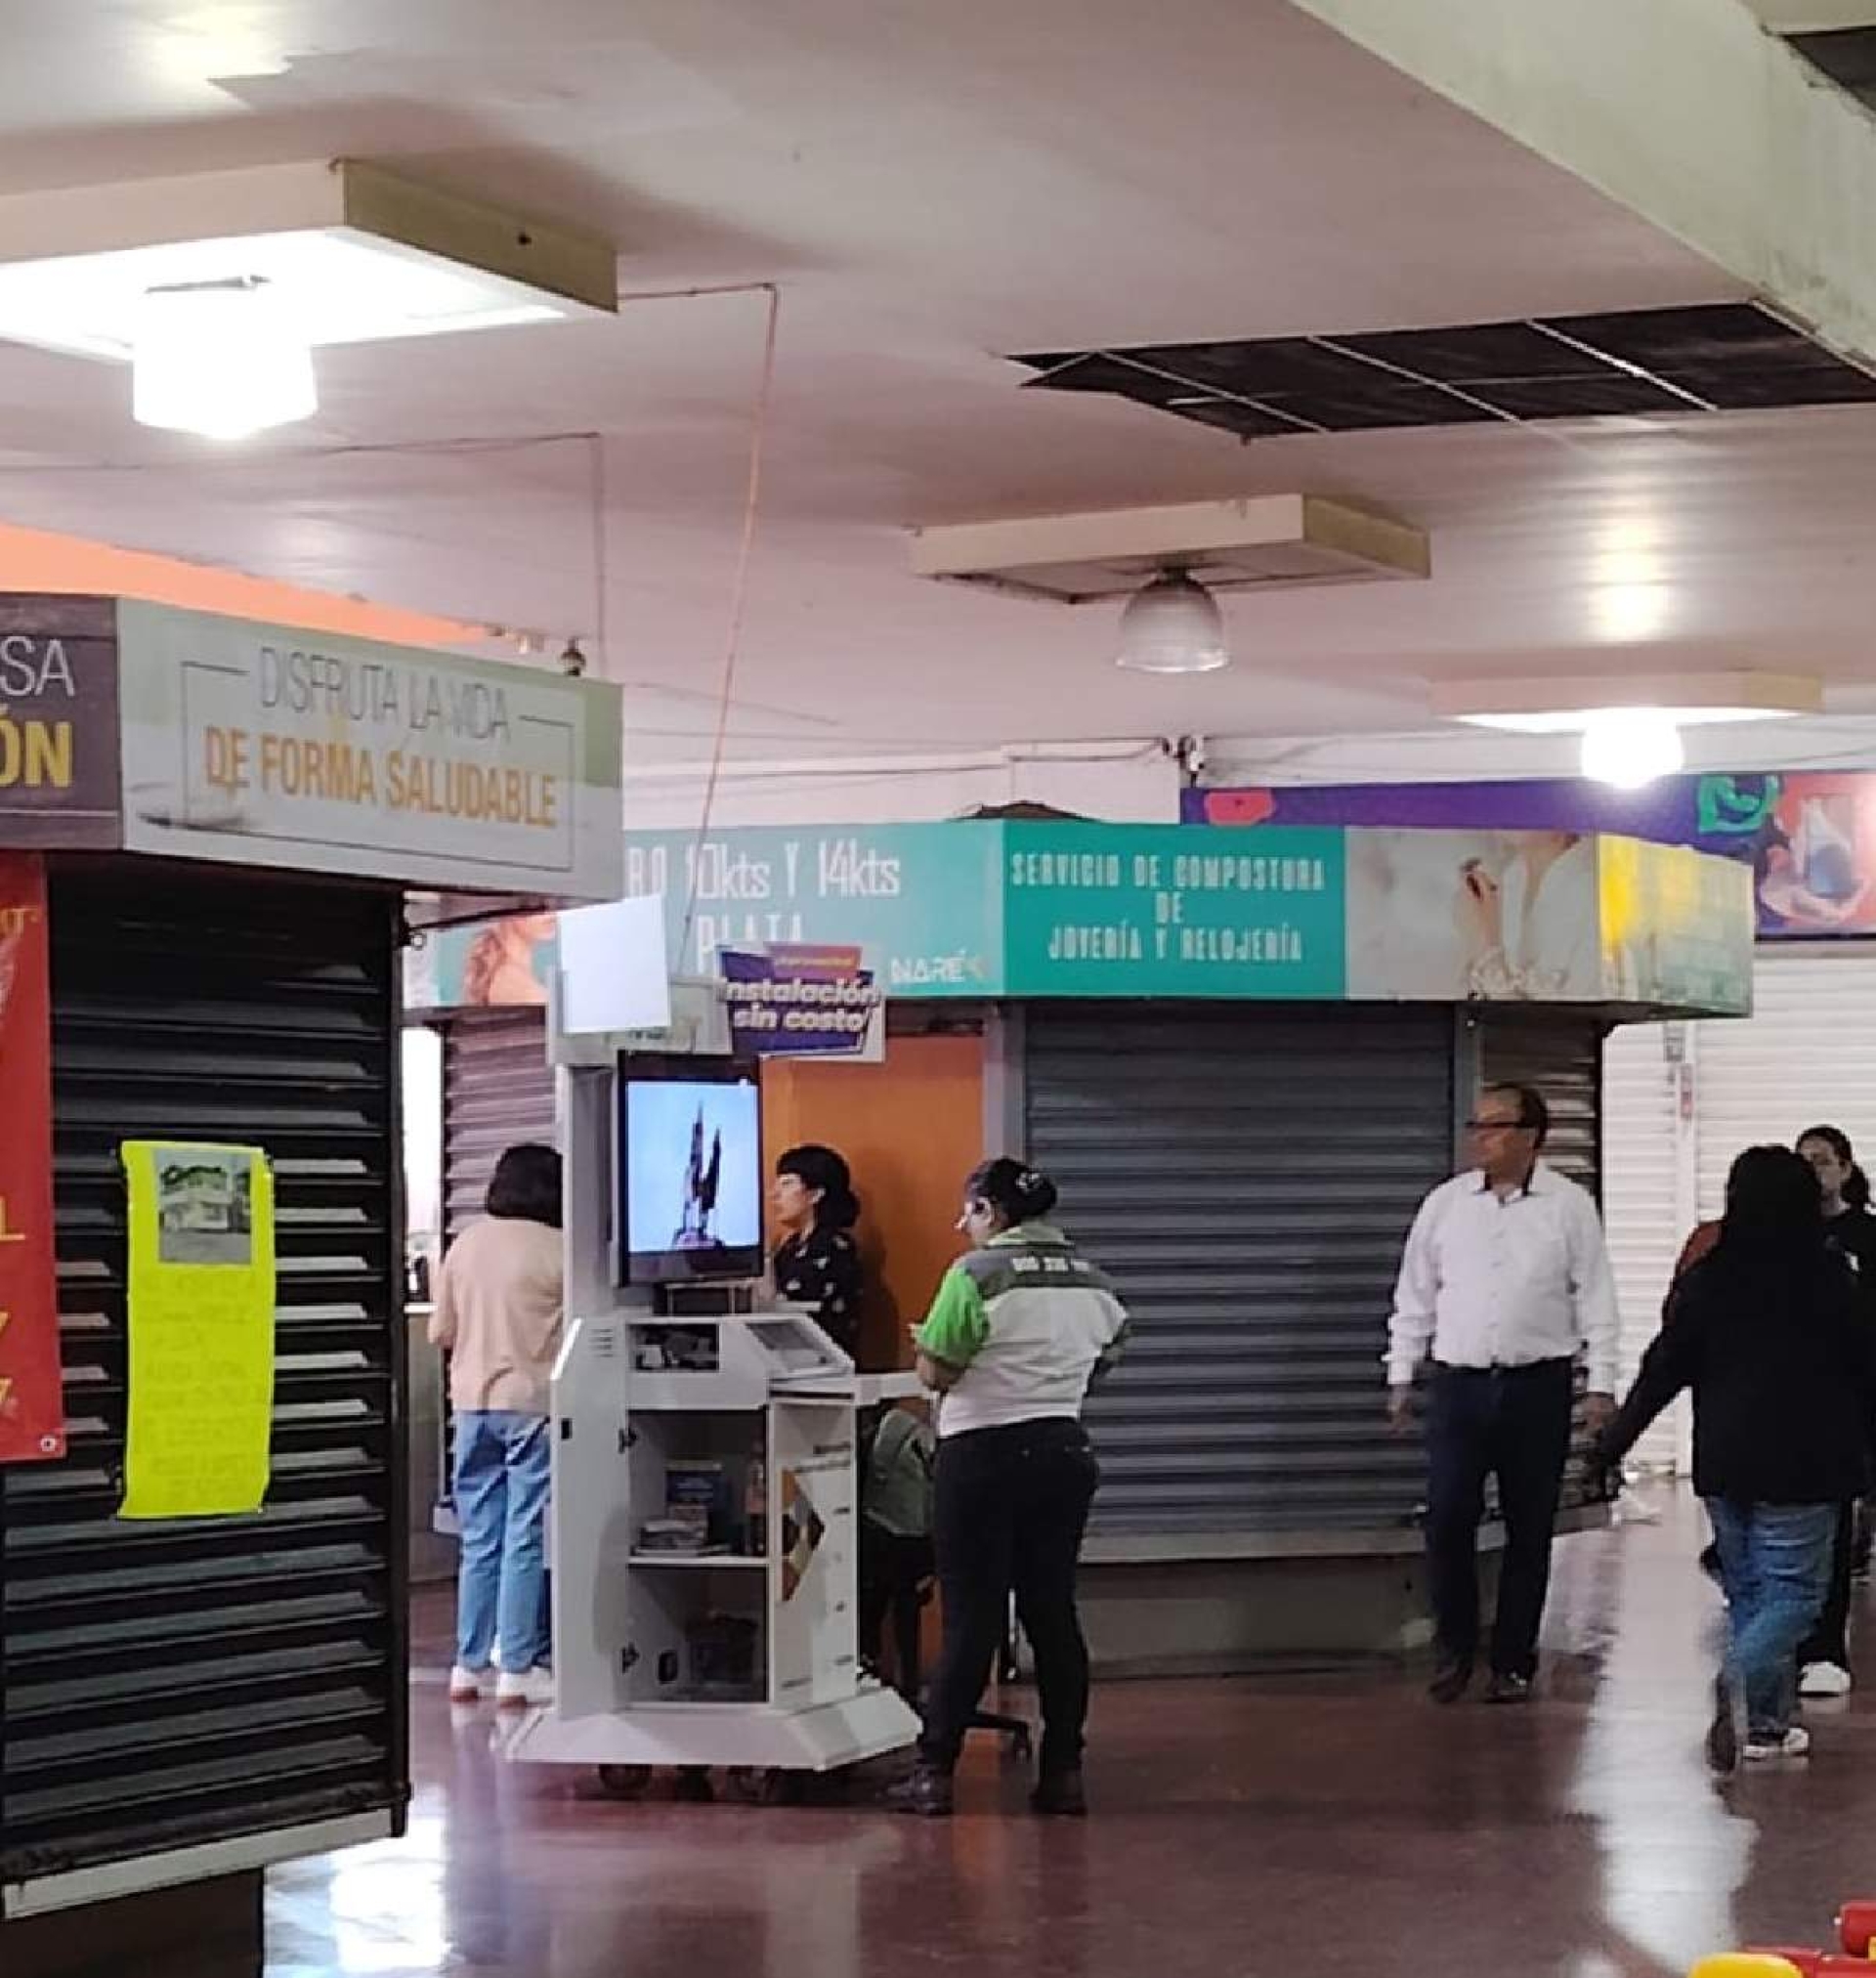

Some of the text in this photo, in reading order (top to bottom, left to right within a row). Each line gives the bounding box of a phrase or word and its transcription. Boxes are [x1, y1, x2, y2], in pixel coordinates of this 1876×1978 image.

[260, 646, 400, 724] DISFRUTA
[408, 674, 442, 730] LA
[205, 724, 558, 829] DE FORMA SALUDABLE
[784, 840, 800, 897] Y
[1011, 852, 1325, 891] SERVICIO DE COMPOSTURA
[1155, 890, 1184, 924] DE
[1155, 927, 1168, 960] Y
[1182, 921, 1301, 961] RELOJERÍA
[734, 1001, 778, 1029] sin
